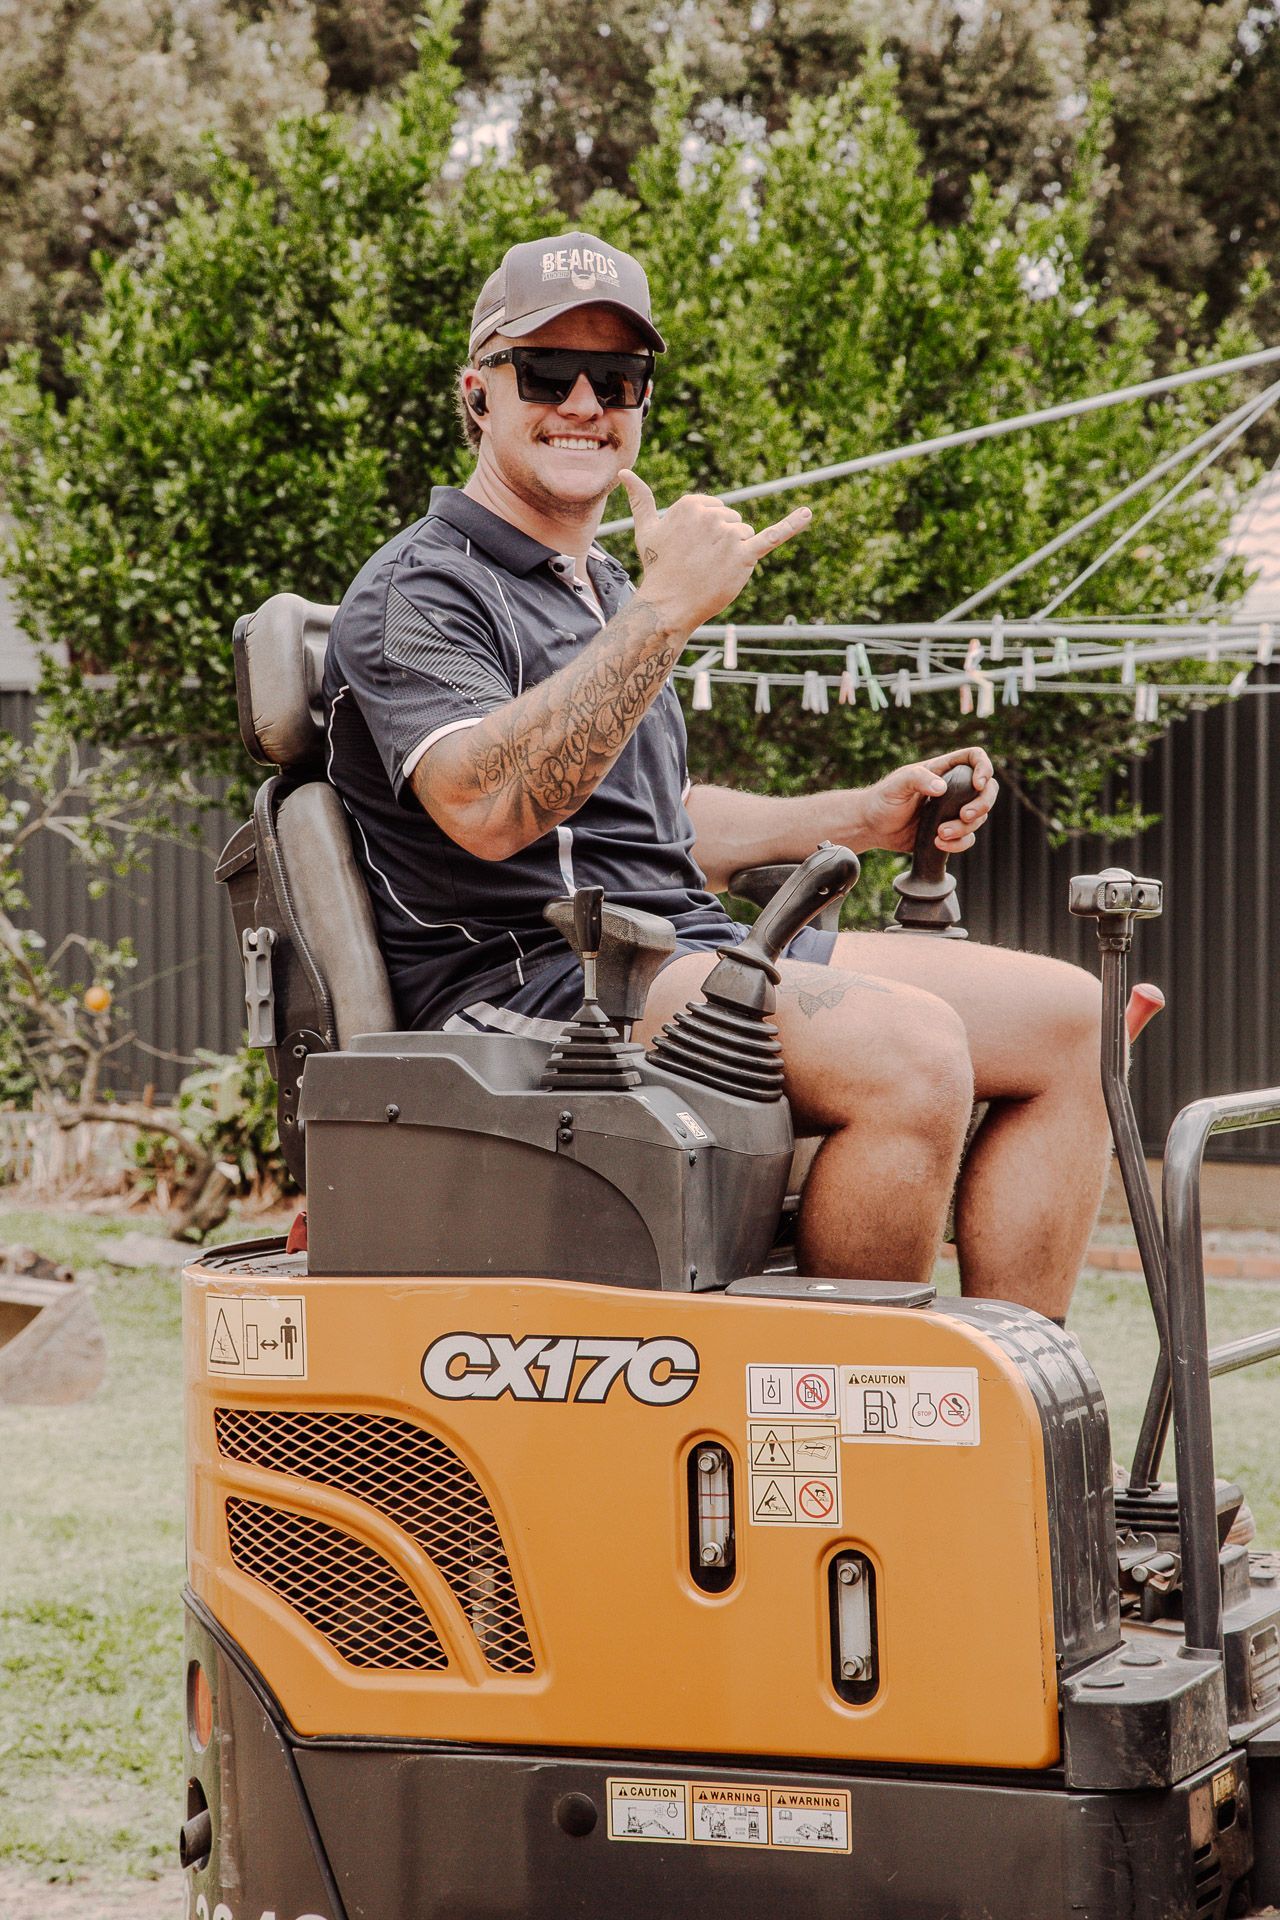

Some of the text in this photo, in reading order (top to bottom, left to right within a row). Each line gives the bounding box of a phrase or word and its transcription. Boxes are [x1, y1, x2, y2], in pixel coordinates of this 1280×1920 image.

[541, 248, 619, 279] BEARDS
[420, 1331, 700, 1407] CX17C
[860, 1374, 906, 1385] CAUTION
[630, 1787, 677, 1798] CAUTION
[710, 1791, 761, 1803] WARNING
[789, 1796, 841, 1808] WARNING
